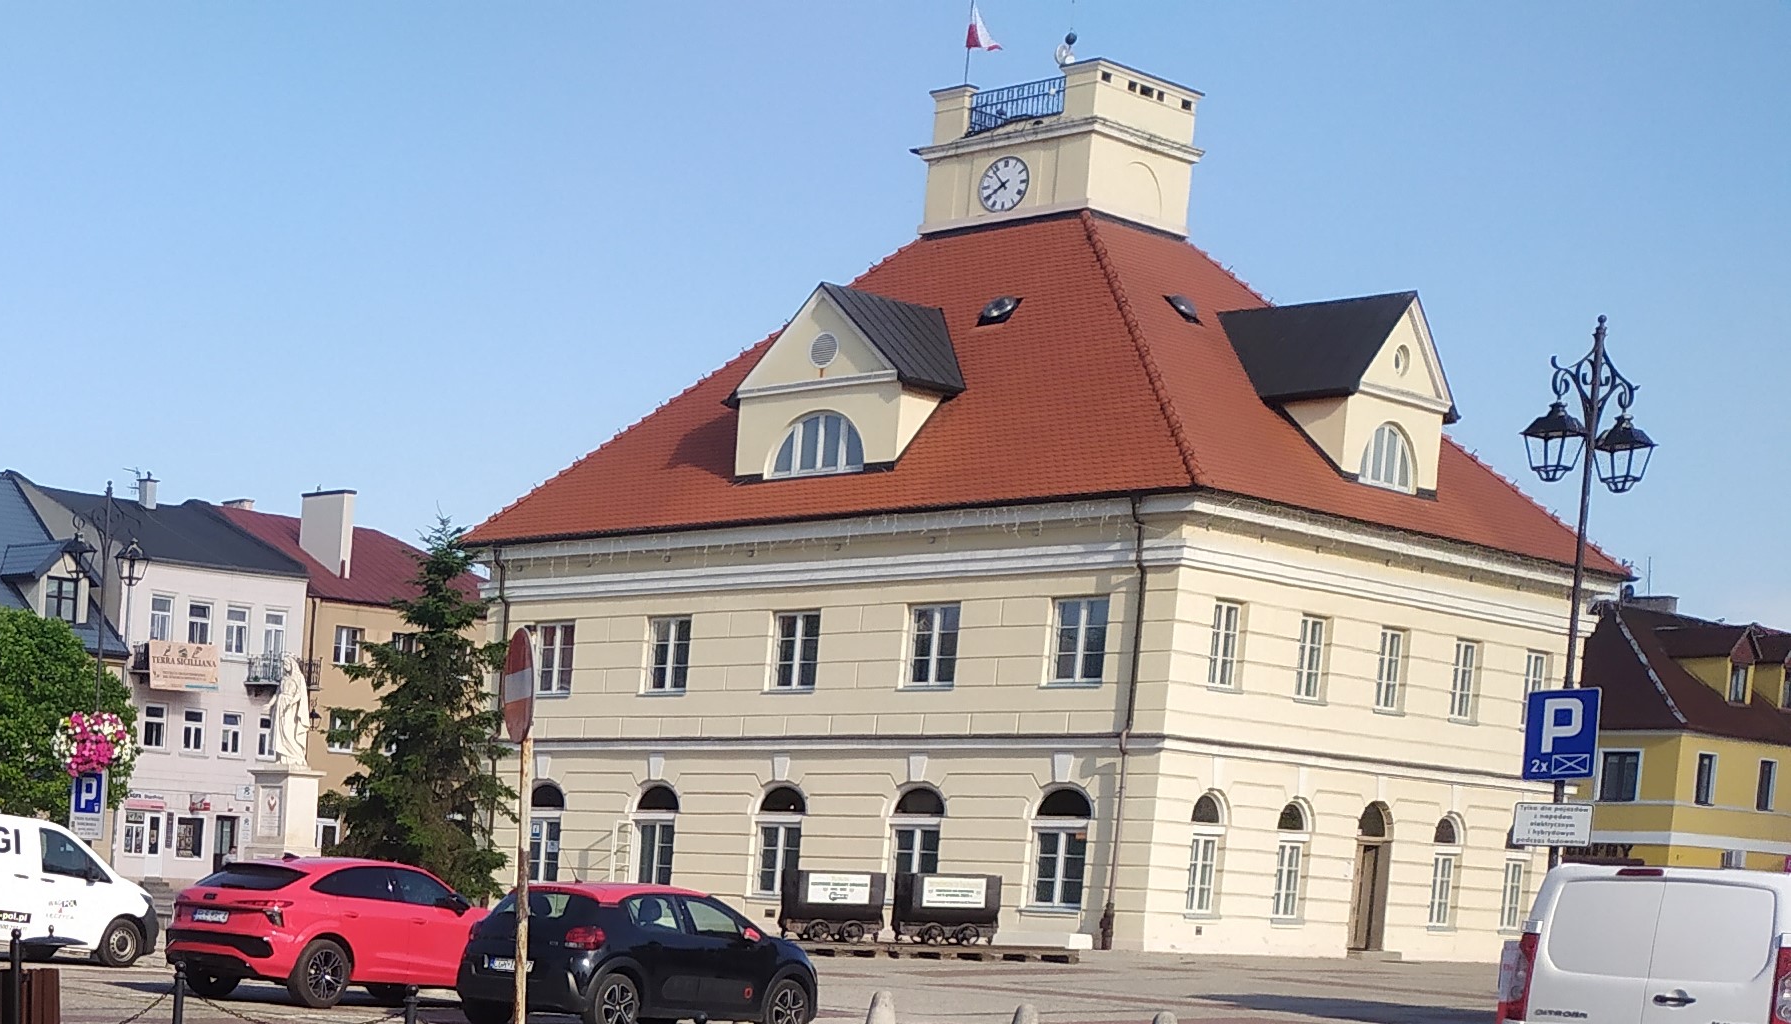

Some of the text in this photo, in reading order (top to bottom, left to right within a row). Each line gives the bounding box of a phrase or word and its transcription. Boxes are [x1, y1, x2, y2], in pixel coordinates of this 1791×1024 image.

[151, 655, 175, 665] TERRA
[1541, 697, 1584, 754] P
[1530, 758, 1549, 773] 2x
[80, 777, 98, 809] P
